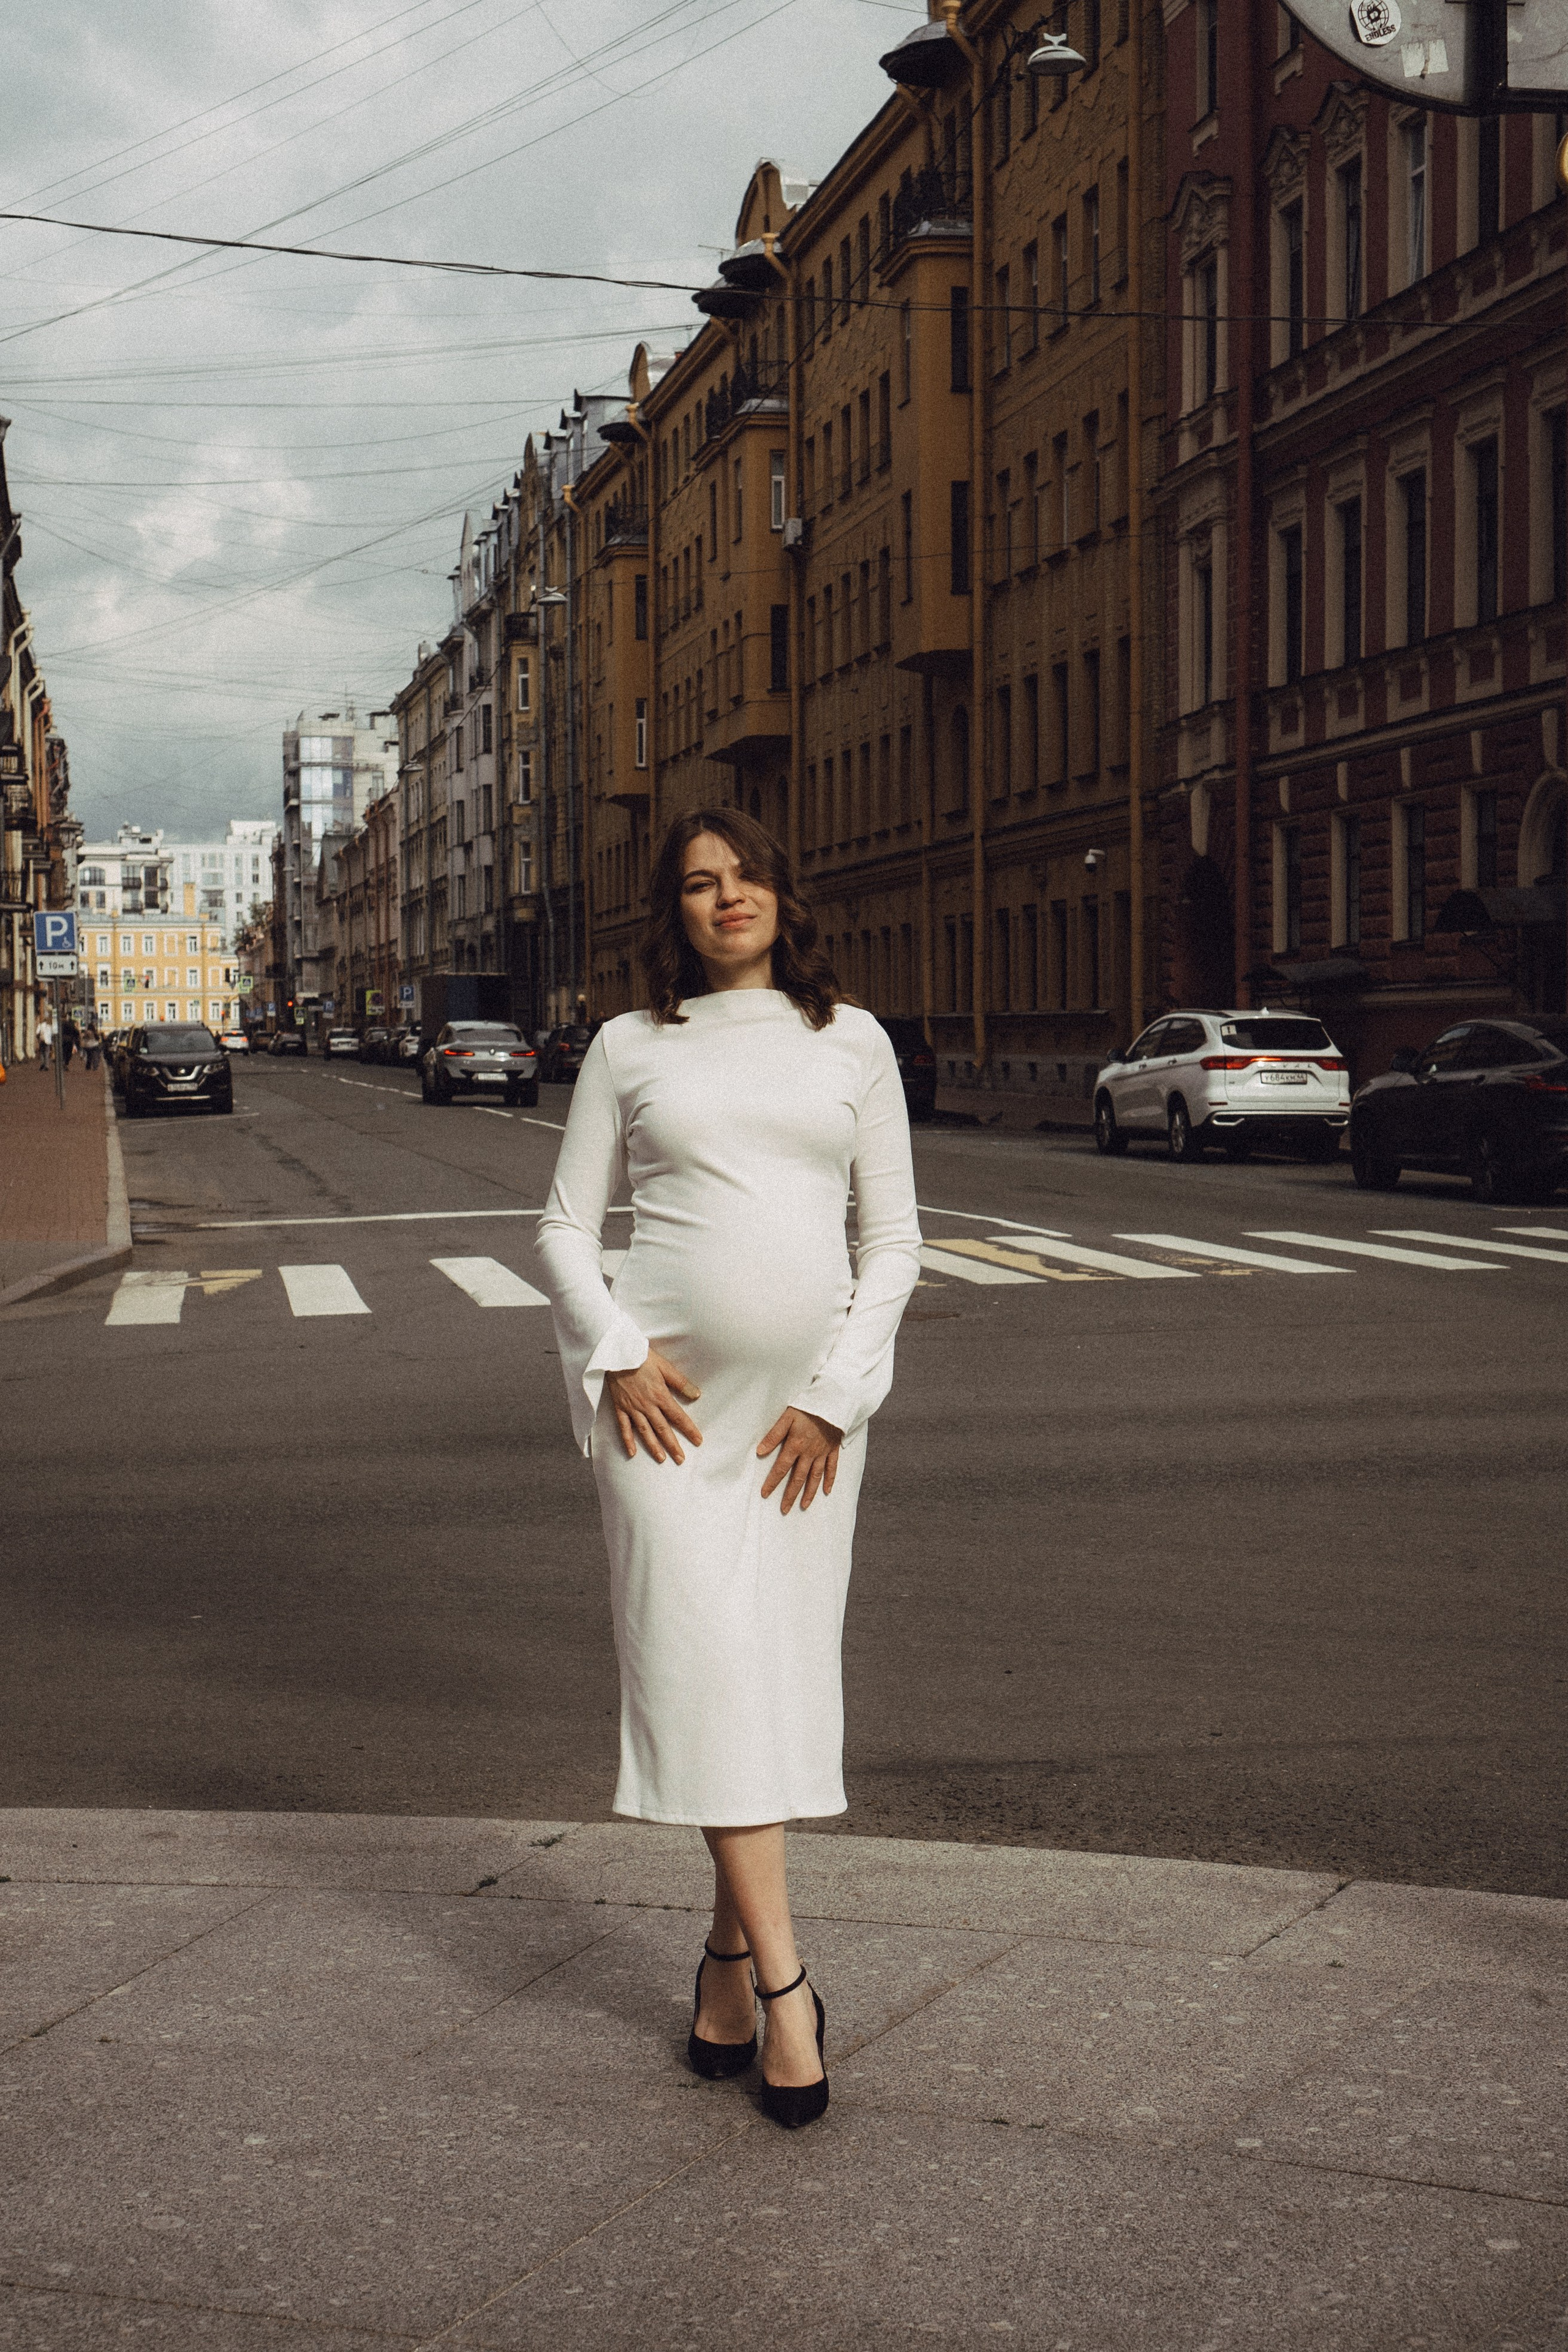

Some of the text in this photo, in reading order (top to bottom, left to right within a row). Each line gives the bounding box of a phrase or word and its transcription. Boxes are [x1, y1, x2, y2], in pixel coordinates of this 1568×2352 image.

[1365, 24, 1396, 42] ENDLESS
[45, 916, 68, 947] P
[404, 987, 412, 999] P
